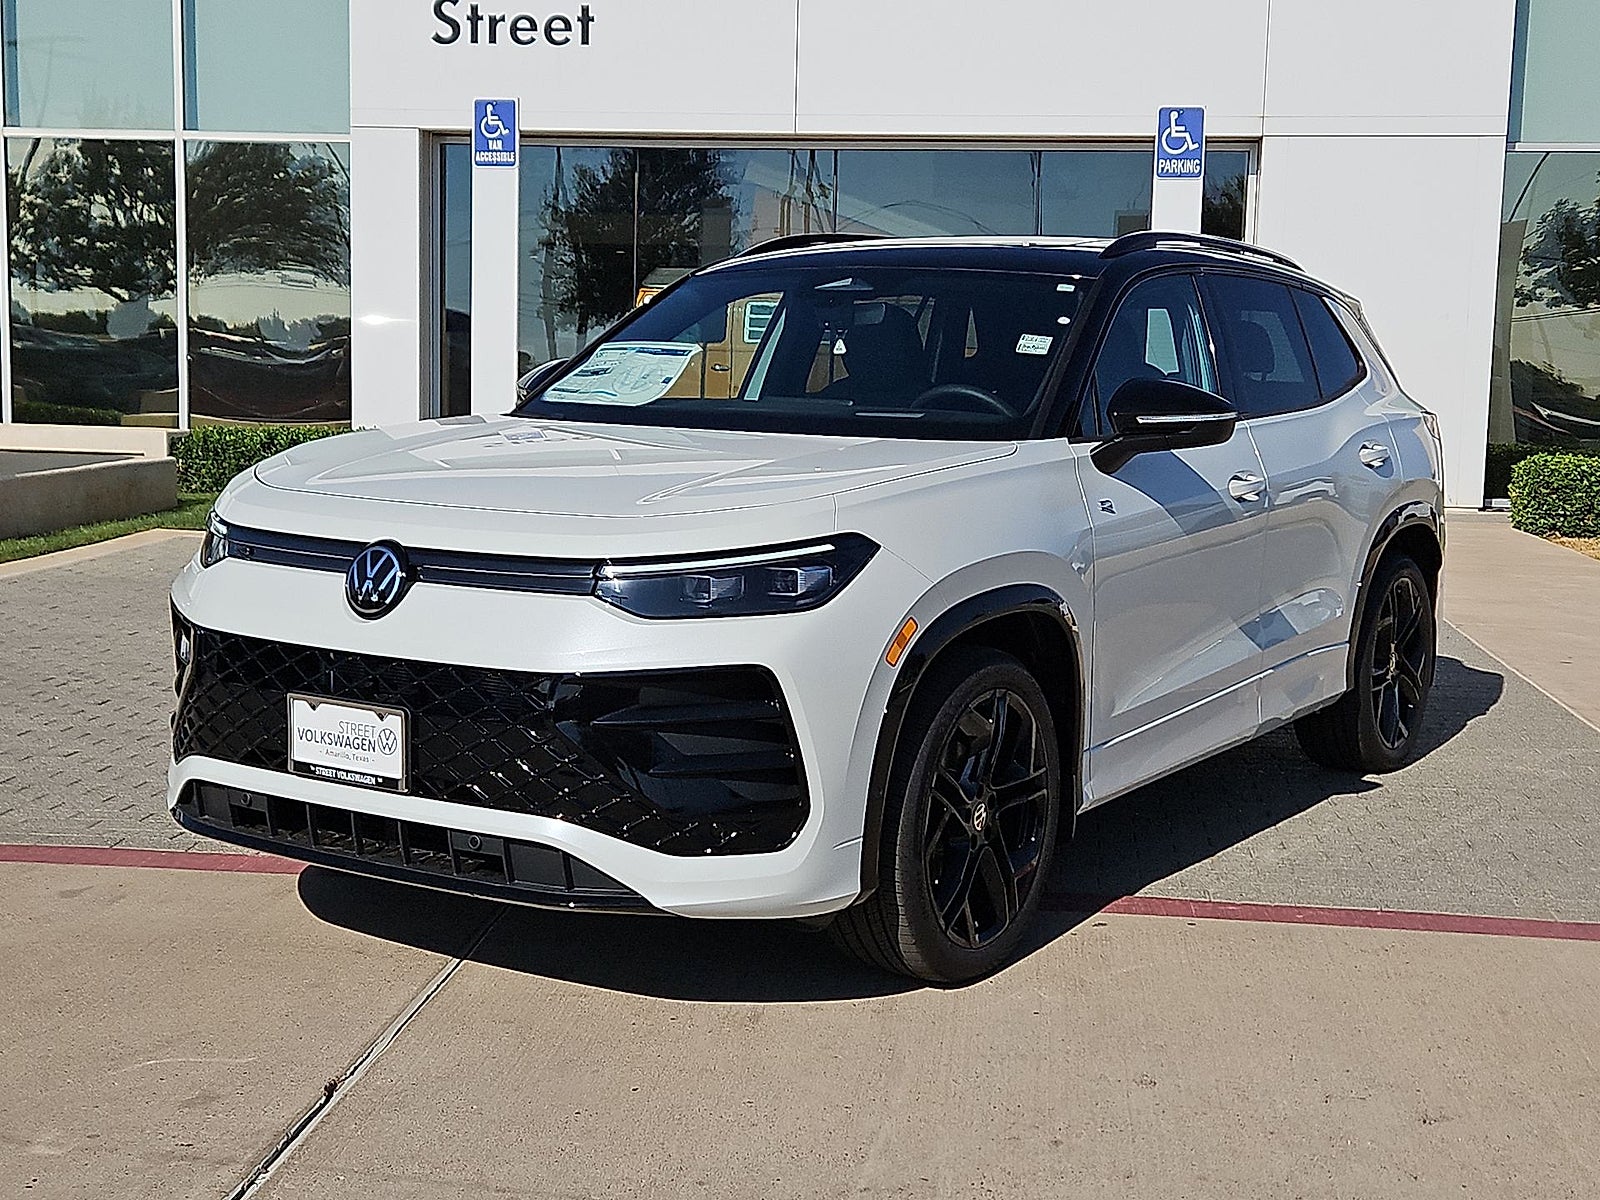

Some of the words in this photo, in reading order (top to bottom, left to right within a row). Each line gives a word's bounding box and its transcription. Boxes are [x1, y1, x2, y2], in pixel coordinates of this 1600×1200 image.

[431, 0, 595, 46] Street
[488, 139, 503, 150] VAN
[475, 151, 515, 162] ACCESSIBLE
[1158, 158, 1201, 174] PARKING
[338, 720, 377, 739] STREET
[297, 727, 376, 753] VOLKSWAGEN
[352, 753, 370, 763] Texas
[315, 765, 336, 778] STREET
[336, 770, 376, 785] VOLKSWAGEN
